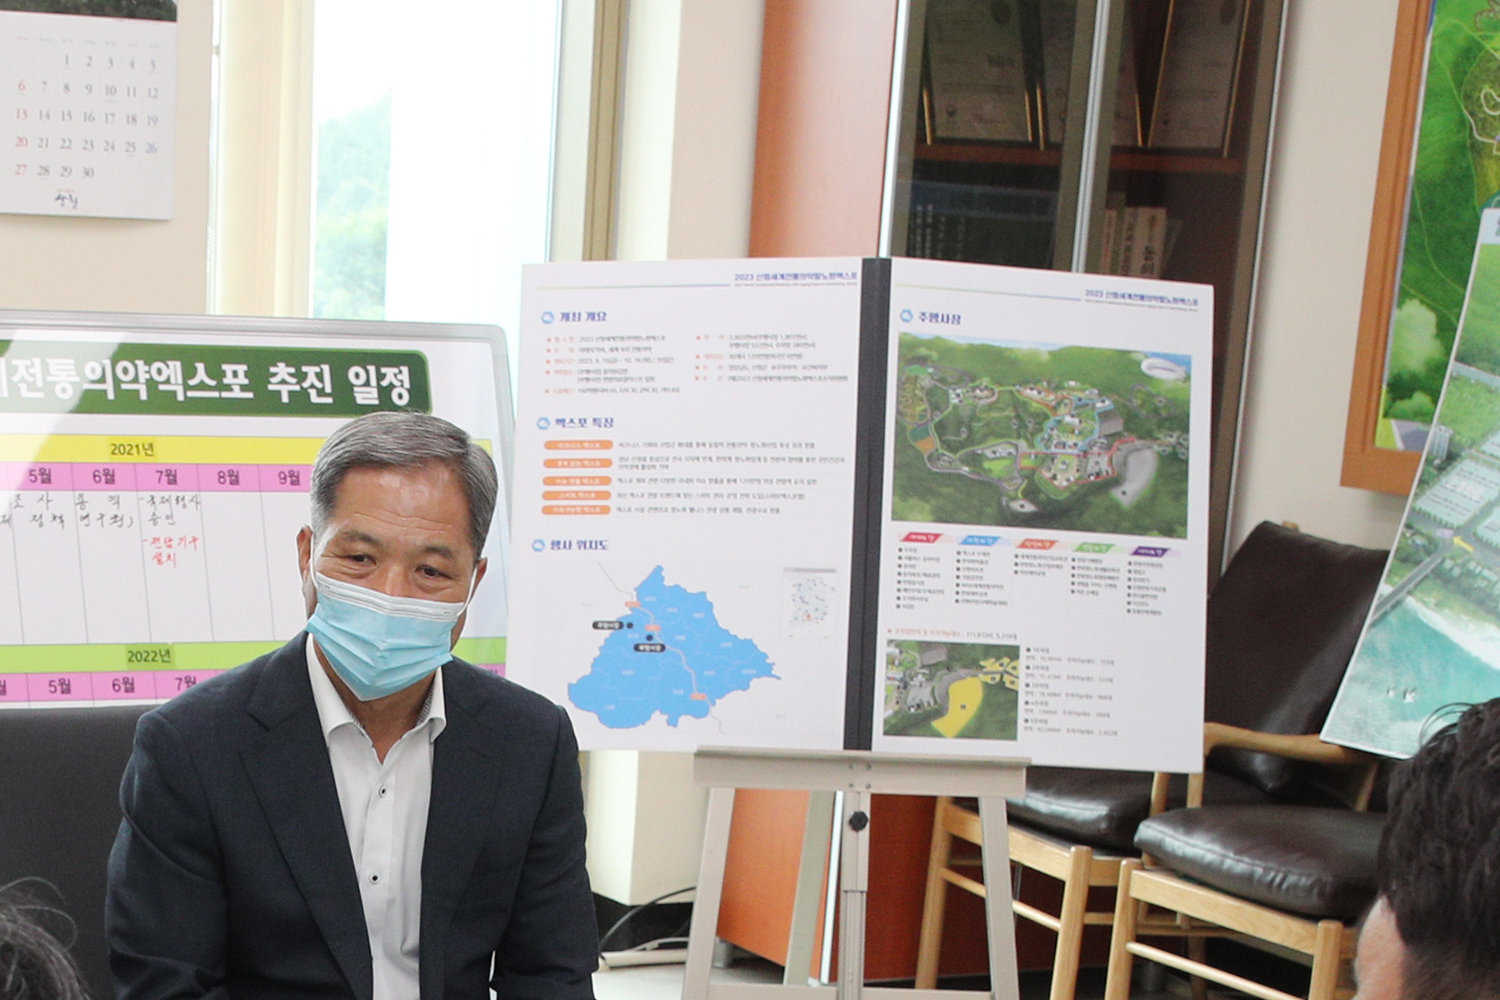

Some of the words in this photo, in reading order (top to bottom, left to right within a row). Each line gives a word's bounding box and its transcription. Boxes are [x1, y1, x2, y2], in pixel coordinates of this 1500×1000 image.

[64, 54, 70, 66] 1
[86, 55, 93, 67] 2
[107, 57, 114, 69] 3
[129, 58, 136, 69] 4
[150, 59, 157, 71] 5
[18, 80, 26, 91] 6
[41, 81, 48, 92] 7
[63, 82, 71, 94] 8
[85, 84, 93, 95] 9
[104, 85, 117, 96] 10
[126, 86, 137, 97] 11
[147, 87, 159, 99] 12
[16, 109, 28, 120] 13
[38, 110, 50, 121] 14
[61, 110, 72, 121] 15
[83, 112, 95, 122] 16
[104, 113, 115, 124] 17
[126, 114, 137, 125] 18
[147, 115, 158, 126] 19
[15, 137, 28, 148] 20
[37, 137, 49, 148] 21
[60, 138, 72, 150] 22
[82, 139, 94, 150] 23
[103, 140, 115, 152] 24
[125, 142, 137, 153] 25
[145, 142, 158, 153] 26
[15, 164, 27, 175] 27
[37, 165, 50, 177] 28
[60, 166, 72, 178] 29
[83, 167, 95, 178] 30
[919, 311, 961, 326] 주행사장
[267, 362, 334, 405] 추진
[348, 365, 412, 407] 일정
[555, 417, 588, 429] 엑스포
[110, 443, 155, 458] 2021년
[28, 468, 53, 486] 5월
[92, 469, 116, 486] 6월
[155, 469, 179, 487] 7월
[217, 470, 241, 487] 8월
[278, 470, 301, 488] 9월
[551, 539, 572, 551] 행사
[577, 539, 609, 551] 위치도
[127, 648, 172, 664] 2022년
[48, 677, 72, 695] 5월
[112, 676, 136, 694] 6월
